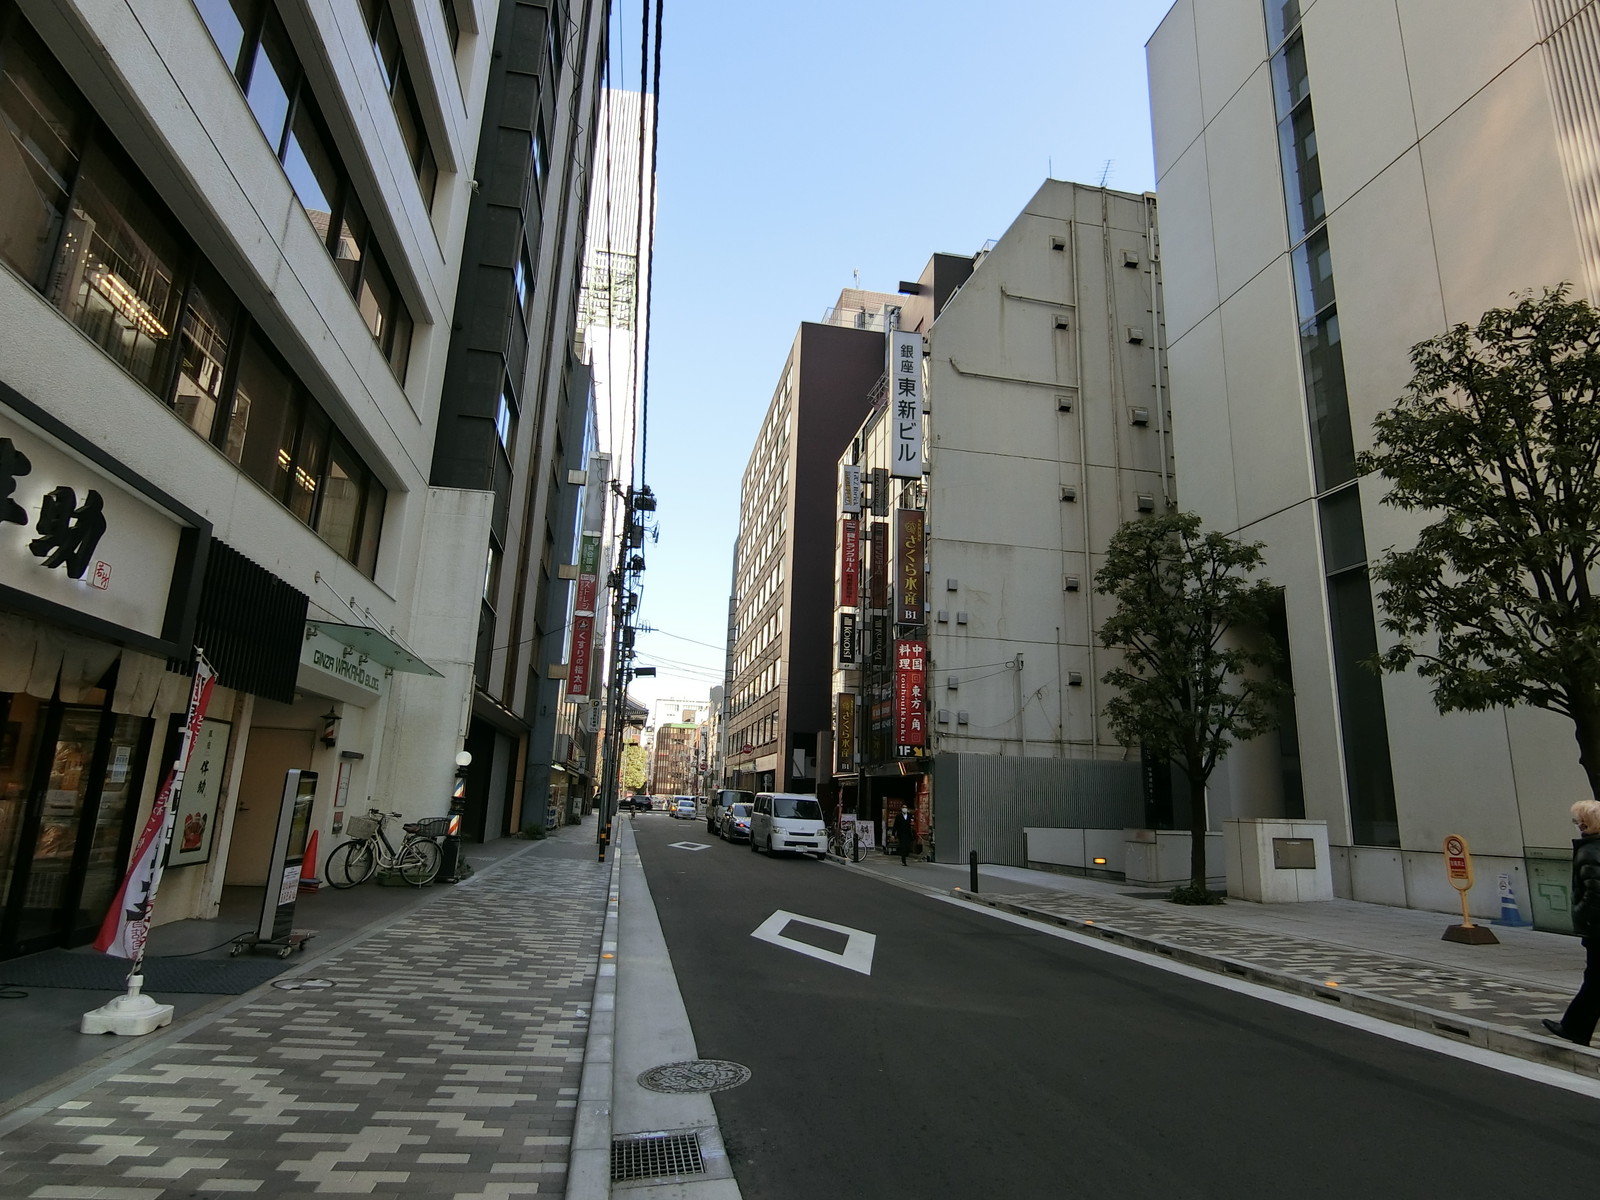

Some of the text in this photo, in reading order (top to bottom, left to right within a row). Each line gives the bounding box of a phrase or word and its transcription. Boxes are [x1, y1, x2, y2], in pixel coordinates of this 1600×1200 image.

[898, 344, 917, 462] 銀座東新ビル
[904, 536, 918, 620] さくら水産 B1
[313, 649, 335, 671] GINZA
[572, 631, 586, 692] くすりの福太郎
[843, 626, 853, 659] KOKOIST
[911, 685, 922, 731] 東方一角
[898, 746, 911, 756] 1F
